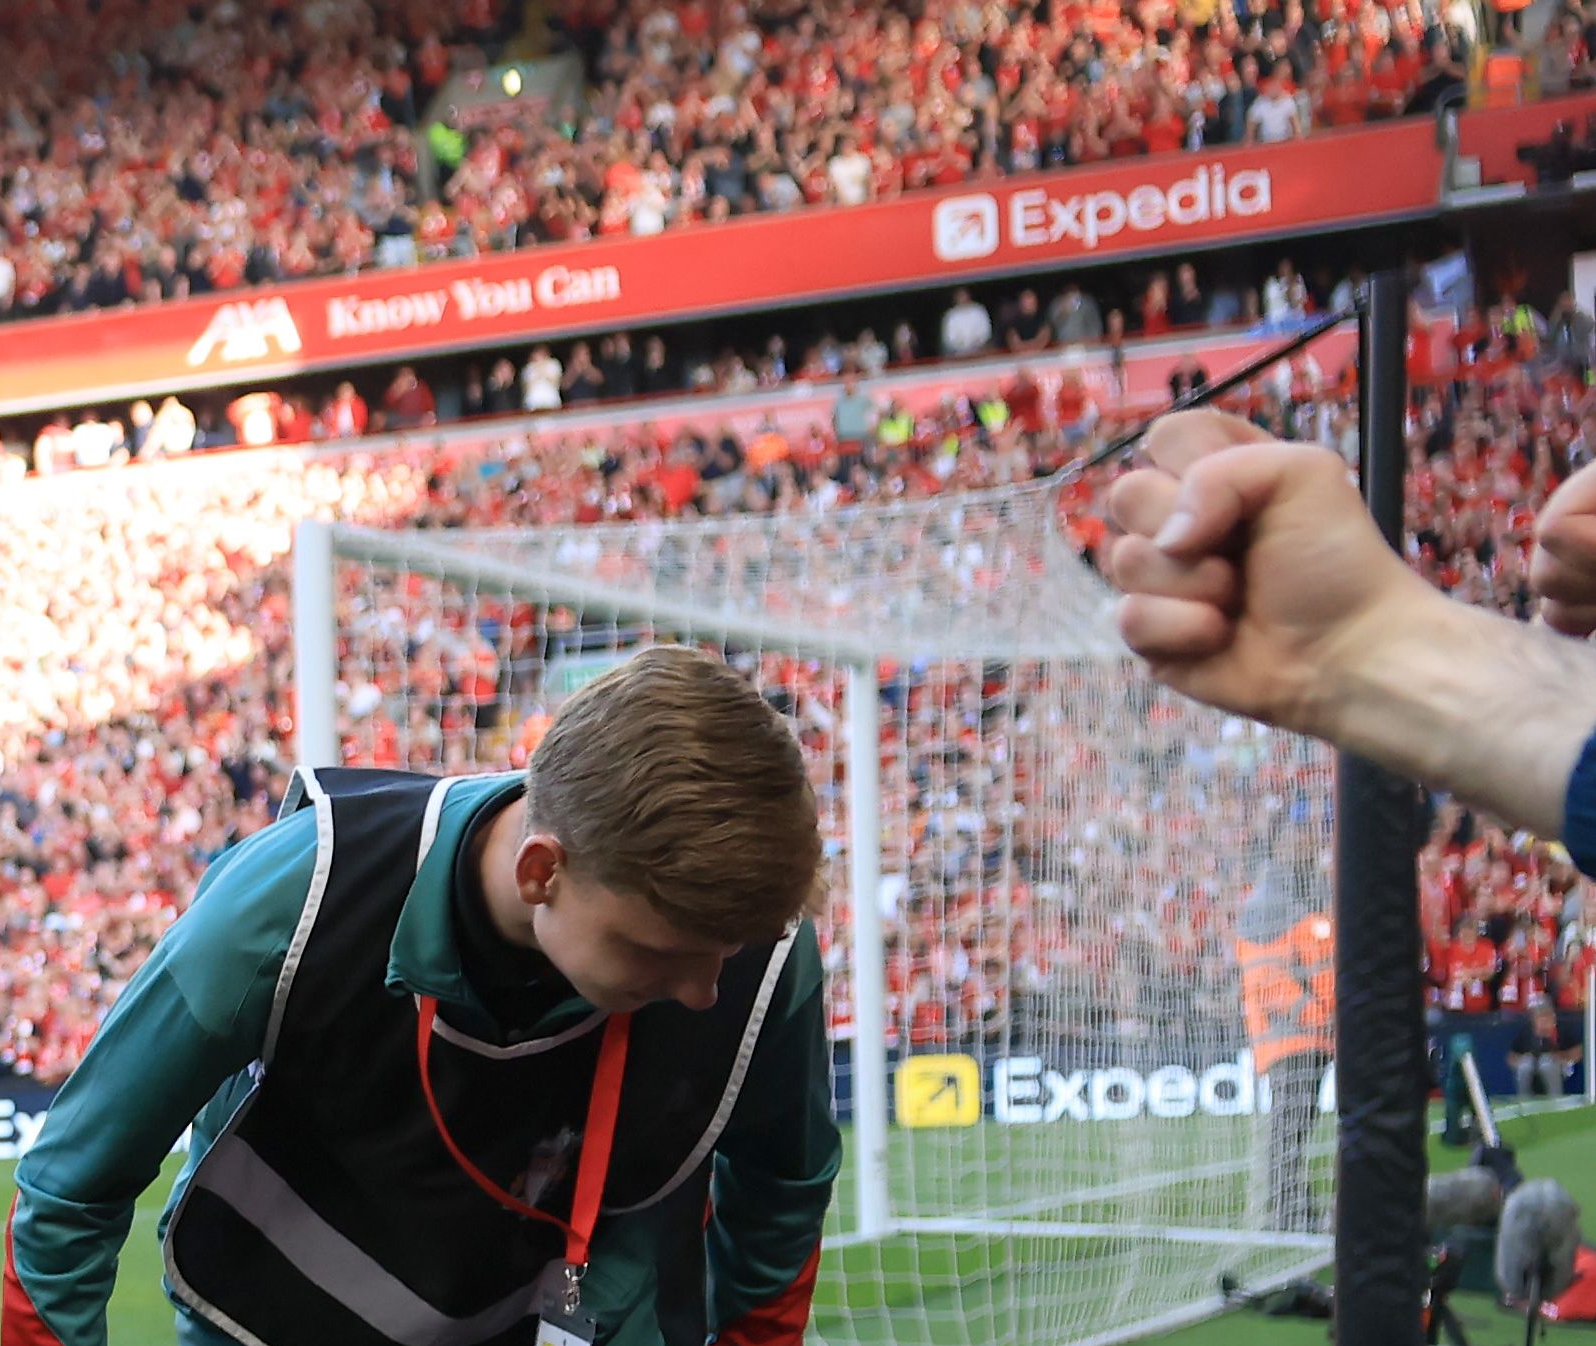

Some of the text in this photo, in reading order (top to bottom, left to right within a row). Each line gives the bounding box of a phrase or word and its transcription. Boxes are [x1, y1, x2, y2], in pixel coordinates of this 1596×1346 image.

[1010, 161, 1273, 249] Expedia
[185, 263, 622, 368] AXA Know You Can
[993, 1046, 1337, 1125] Expedi
